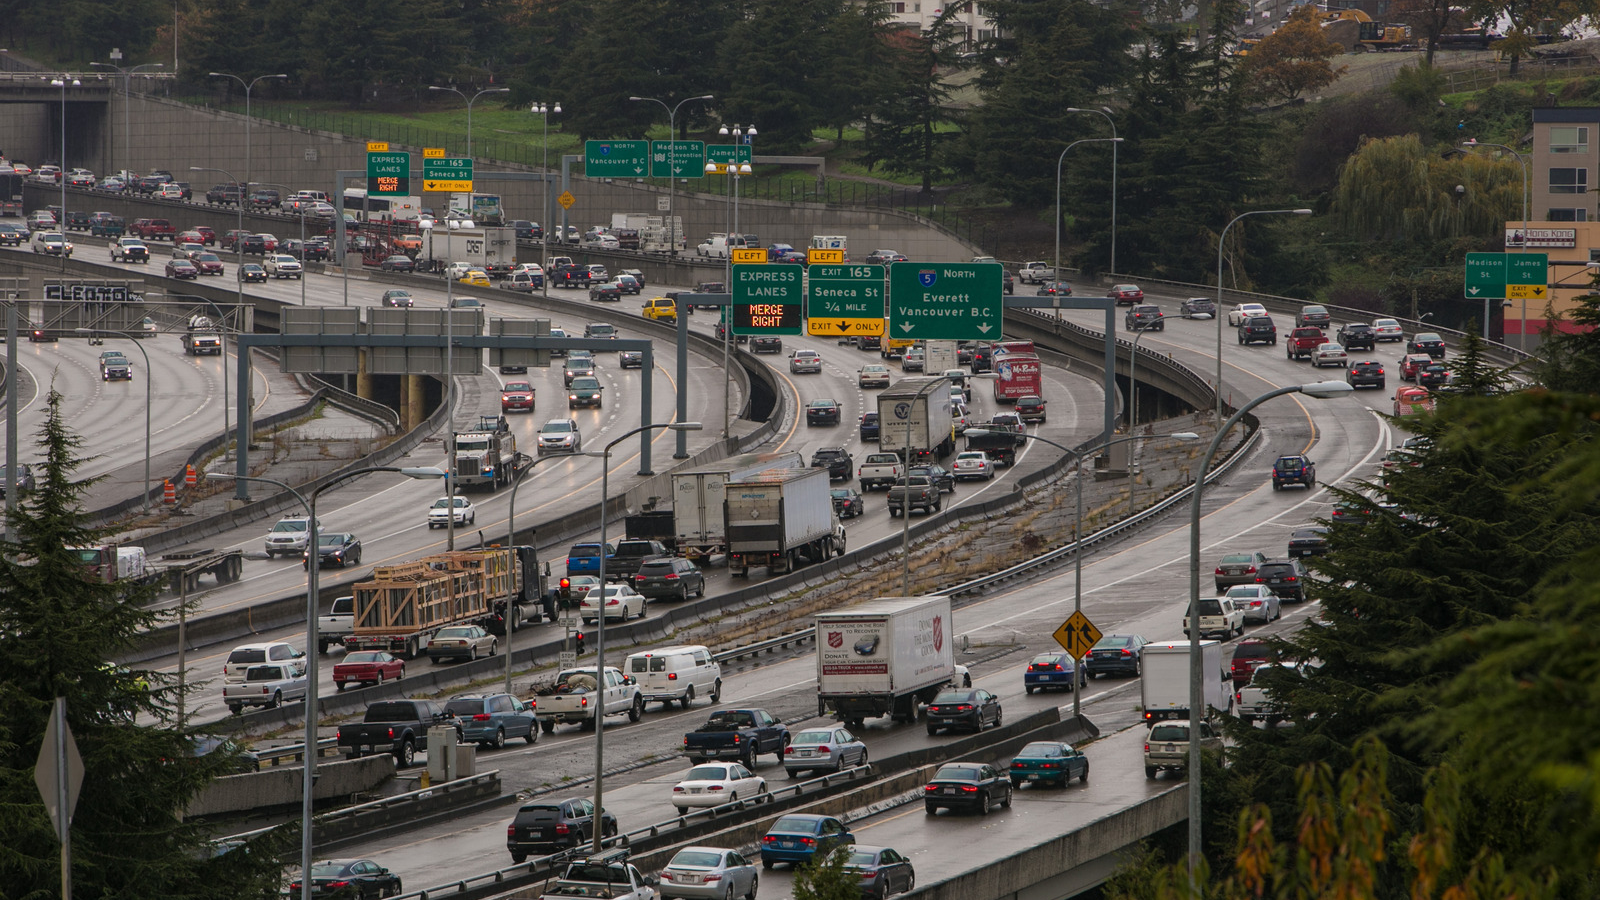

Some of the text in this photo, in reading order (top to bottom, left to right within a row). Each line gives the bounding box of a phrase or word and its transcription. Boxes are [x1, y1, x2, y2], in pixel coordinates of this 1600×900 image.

[740, 272, 795, 281] EXPRESS
[850, 267, 872, 277] 165
[944, 269, 975, 278] NORTH
[924, 275, 931, 283] 5
[747, 288, 787, 296] LANES
[815, 287, 878, 297] Seneca St
[923, 293, 969, 302] Everett
[749, 304, 784, 315] MERGE
[825, 302, 840, 312] 3/4
[899, 307, 994, 317] Vancouver B.C.
[752, 316, 782, 326] RIGHT
